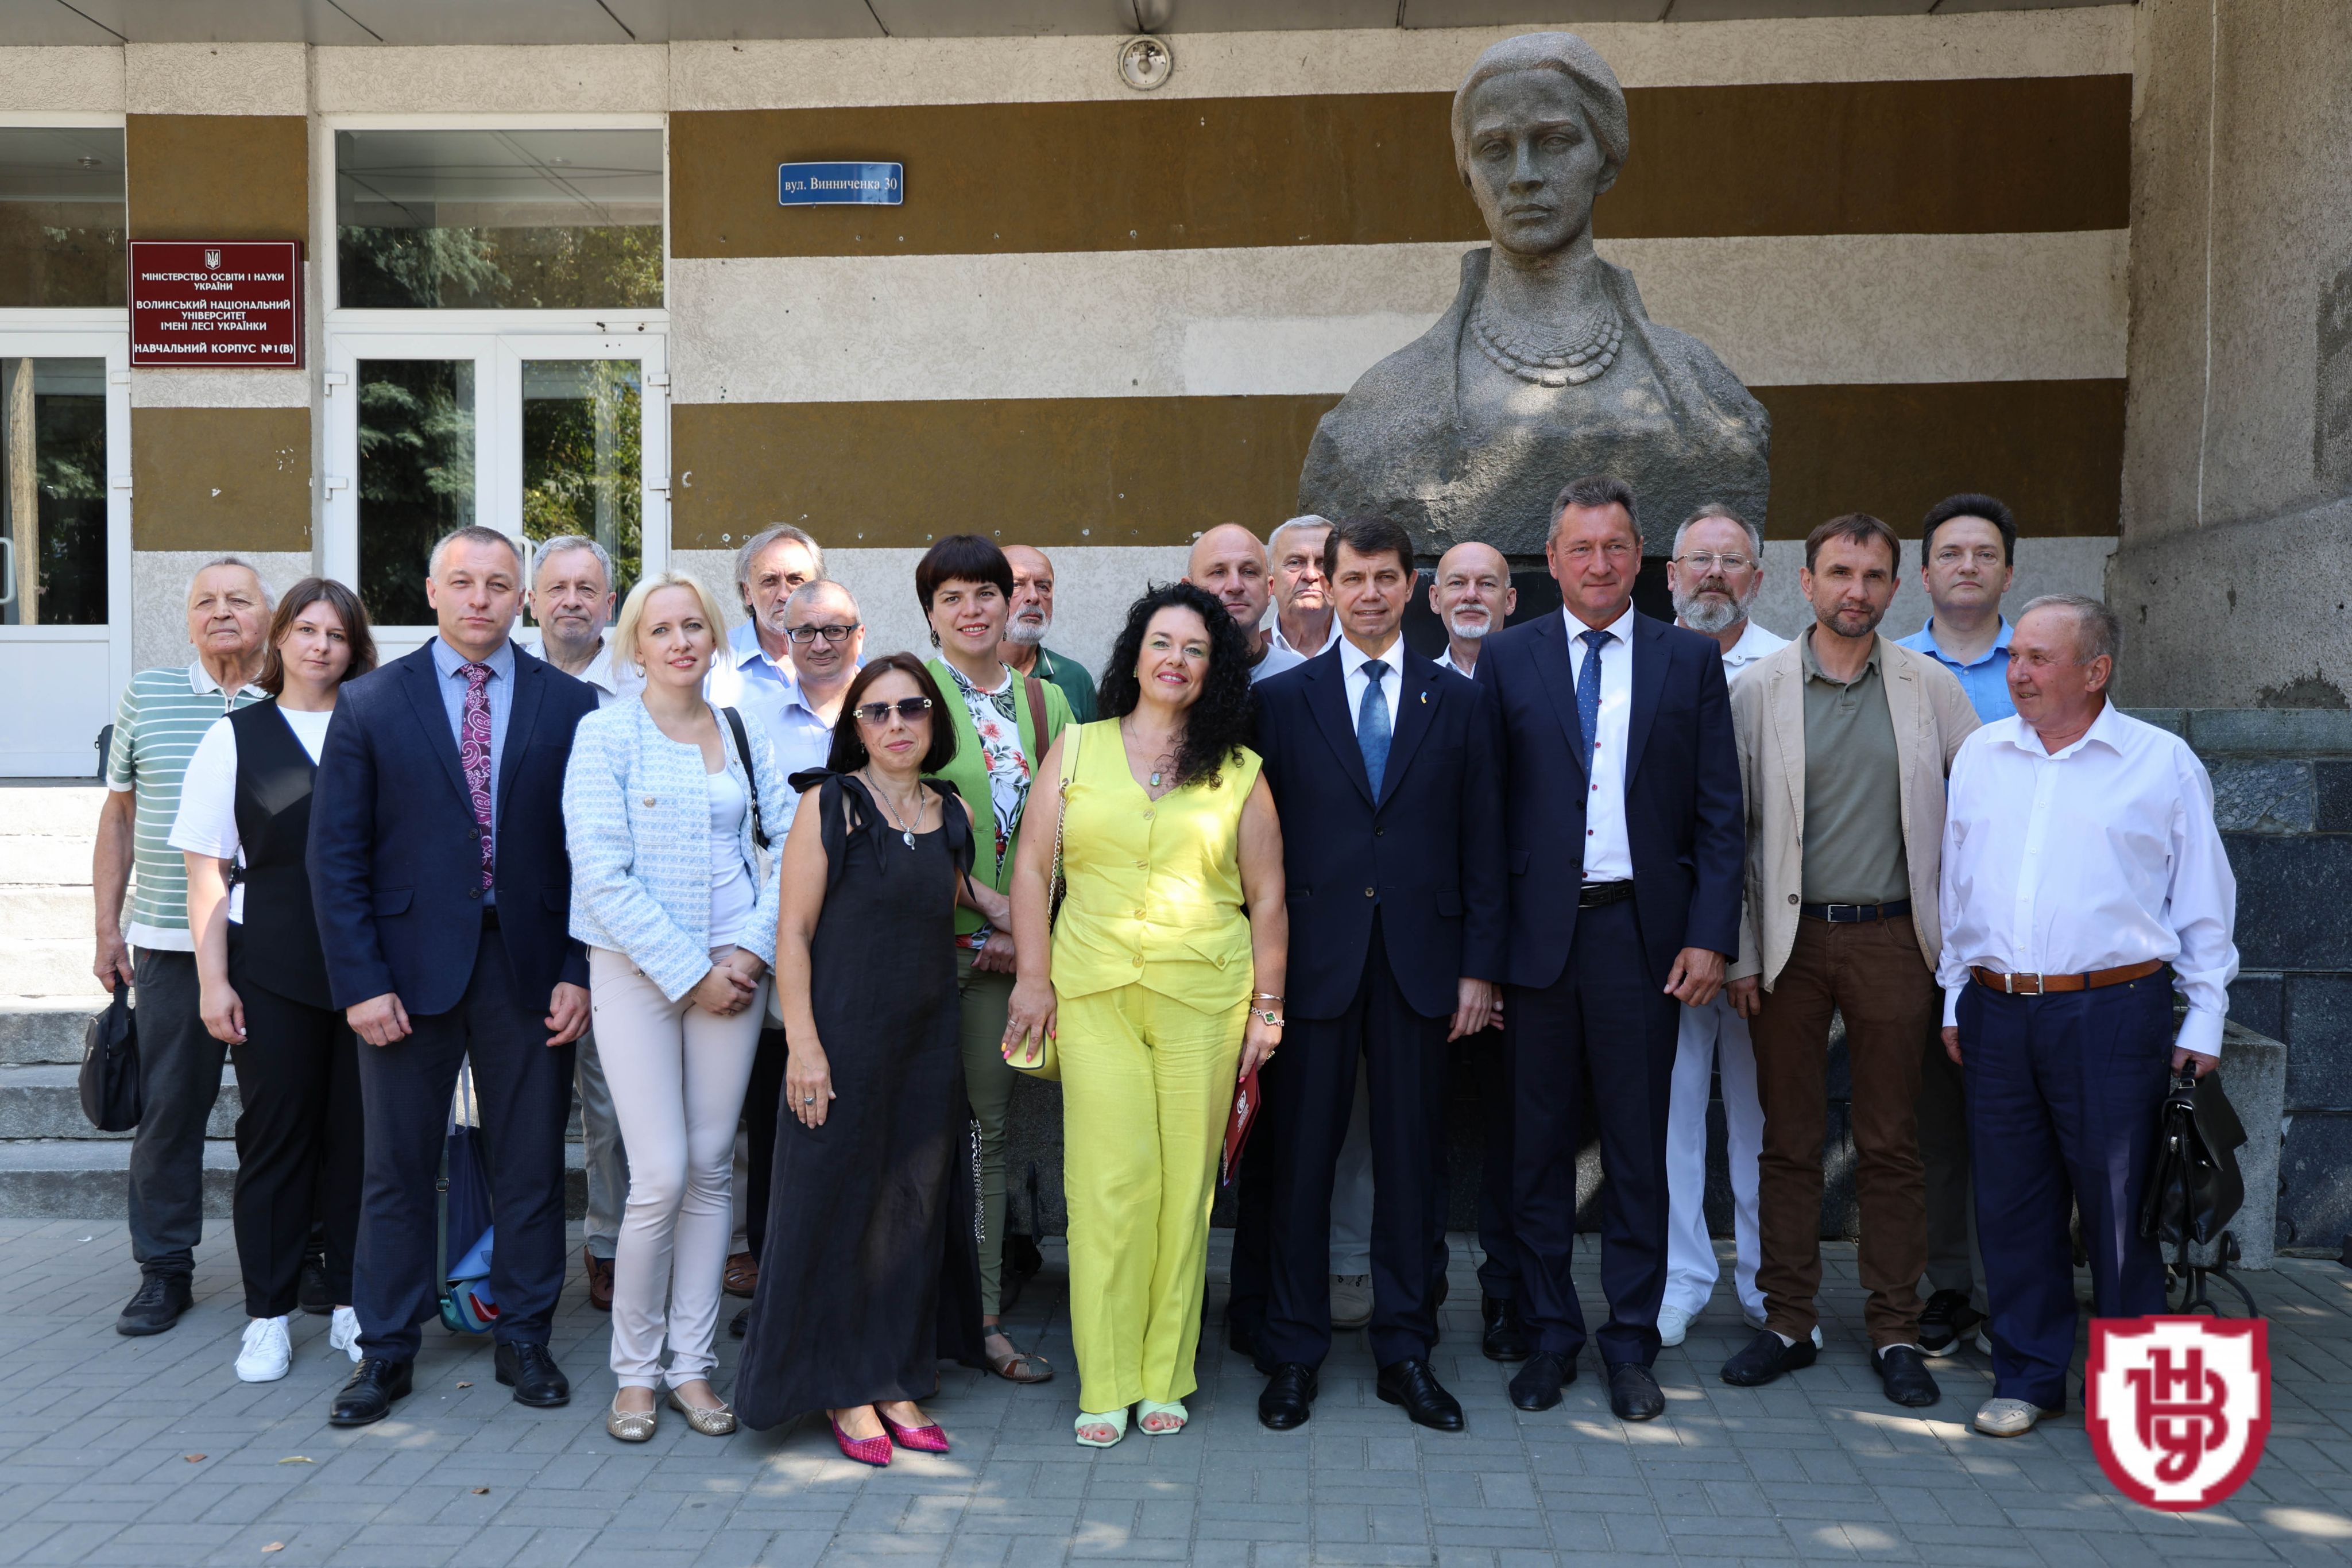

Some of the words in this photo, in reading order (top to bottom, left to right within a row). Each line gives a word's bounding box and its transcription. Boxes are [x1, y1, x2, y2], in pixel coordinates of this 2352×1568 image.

[785, 181, 806, 193] вул.
[810, 177, 880, 189] Винниченка
[884, 177, 898, 190] 30
[142, 273, 207, 281] МІНІСТЕРСТВО
[211, 273, 245, 281] ОСВІТИ
[248, 273, 251, 281] І
[254, 273, 284, 281] НАУКИ
[194, 281, 233, 291] УКРАЇНИ
[136, 299, 207, 309] ВОЛИНСЬКИЙ
[211, 299, 291, 310] НАЦІОНАЛЬНИЙ
[181, 311, 246, 320] УНІВЕРСИТЕТ
[161, 322, 187, 330] ІМЕНІ
[191, 322, 214, 330] ЛЕСІ
[218, 321, 266, 331] УКРАЇНКИ
[134, 342, 207, 353] НАВЧАЛЬНИЙ
[211, 344, 256, 353] КОРПУС
